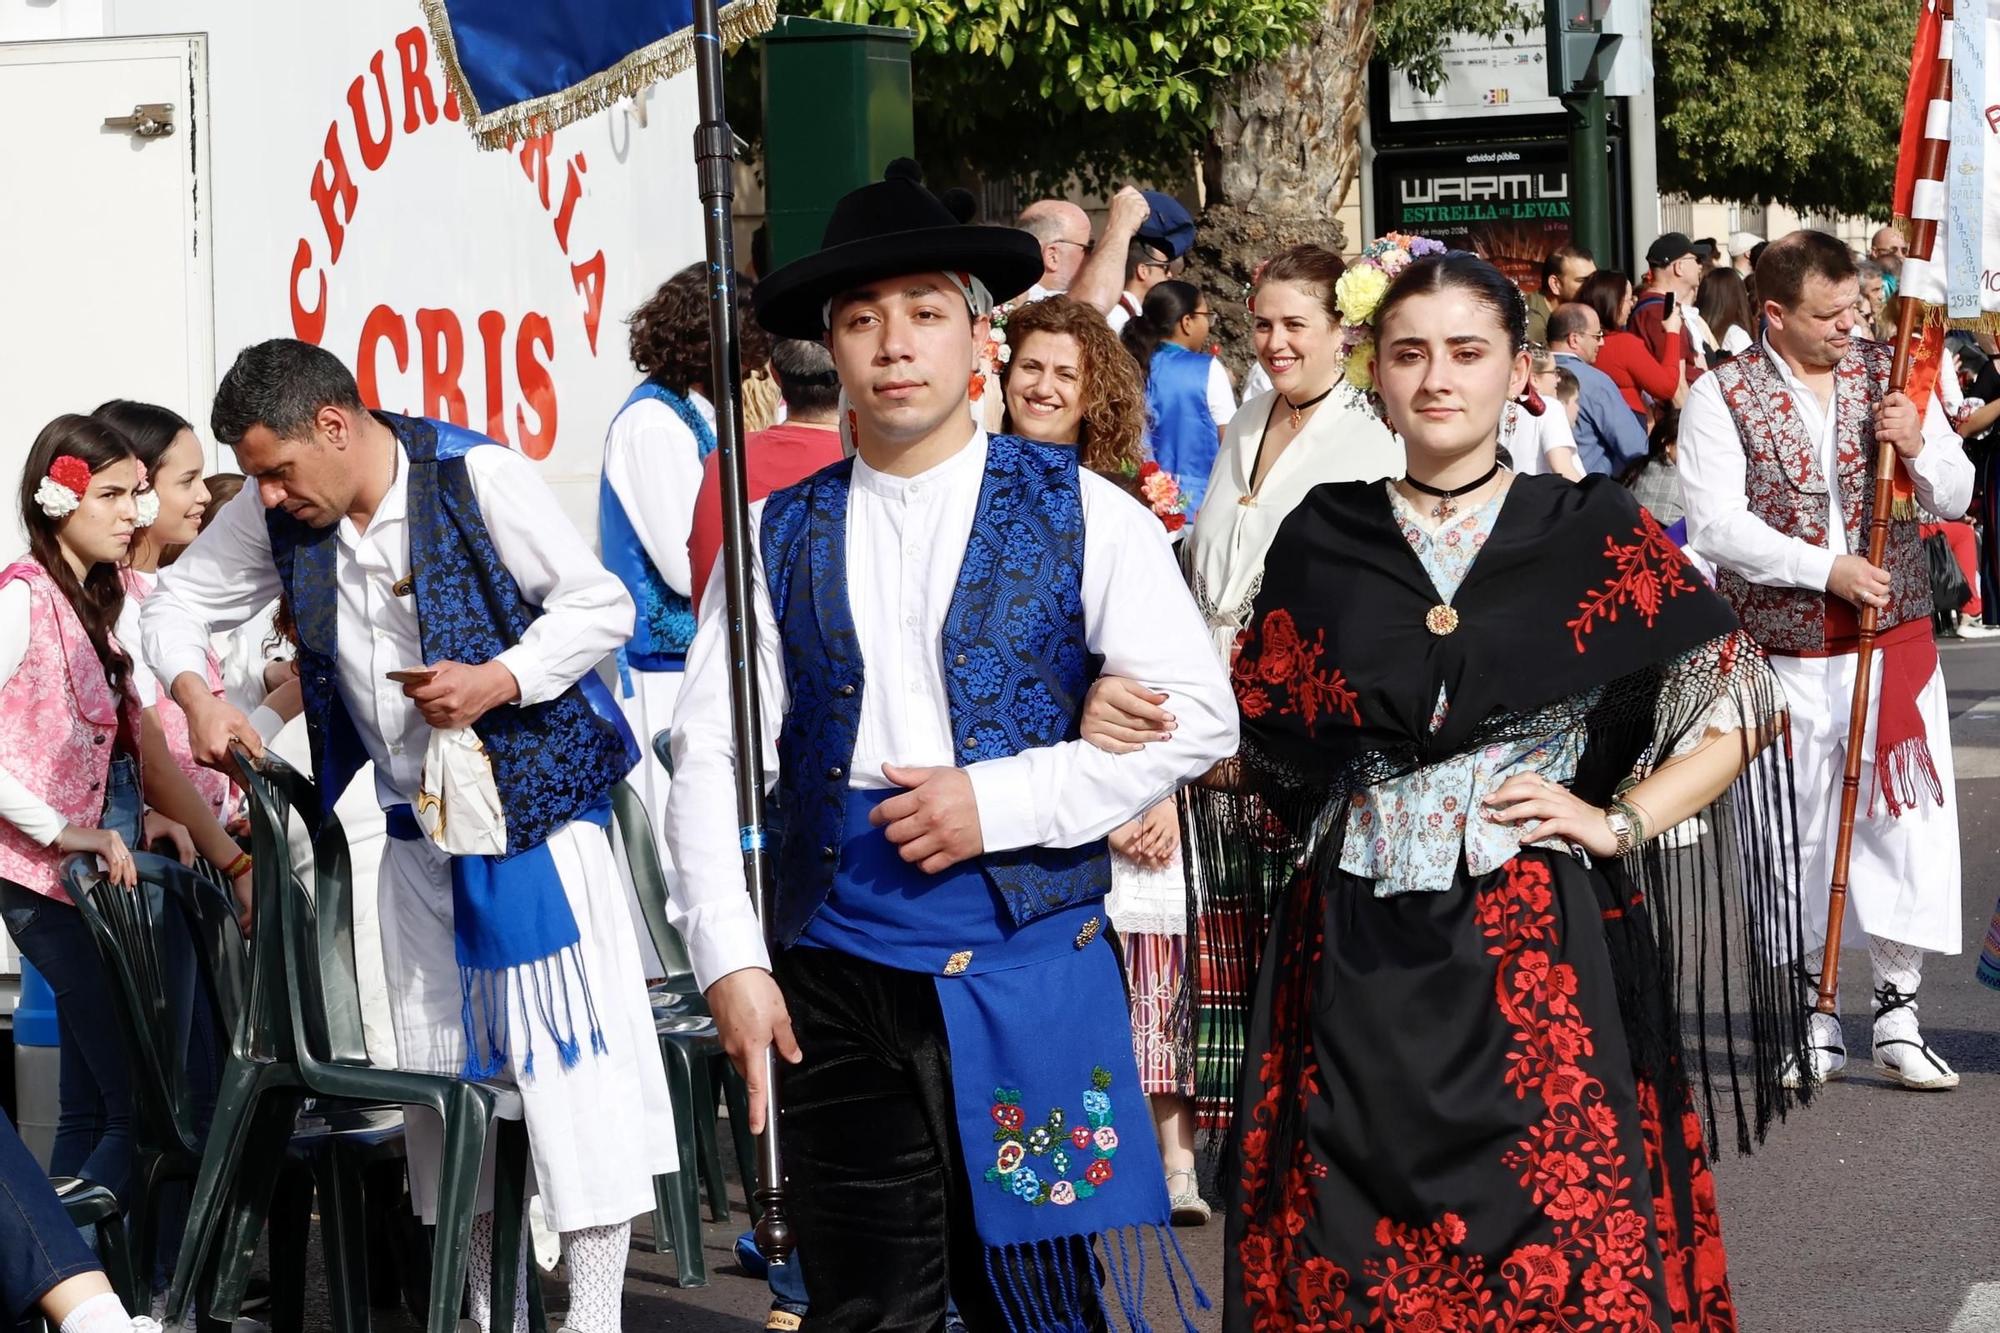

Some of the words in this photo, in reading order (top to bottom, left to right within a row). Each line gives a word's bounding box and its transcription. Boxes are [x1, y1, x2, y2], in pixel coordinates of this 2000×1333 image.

[290, 26, 605, 358] CHURRÍA
[1402, 204, 1498, 223] ESTRELLA
[1951, 293, 1979, 308] 1987
[357, 304, 558, 460] CRIS
